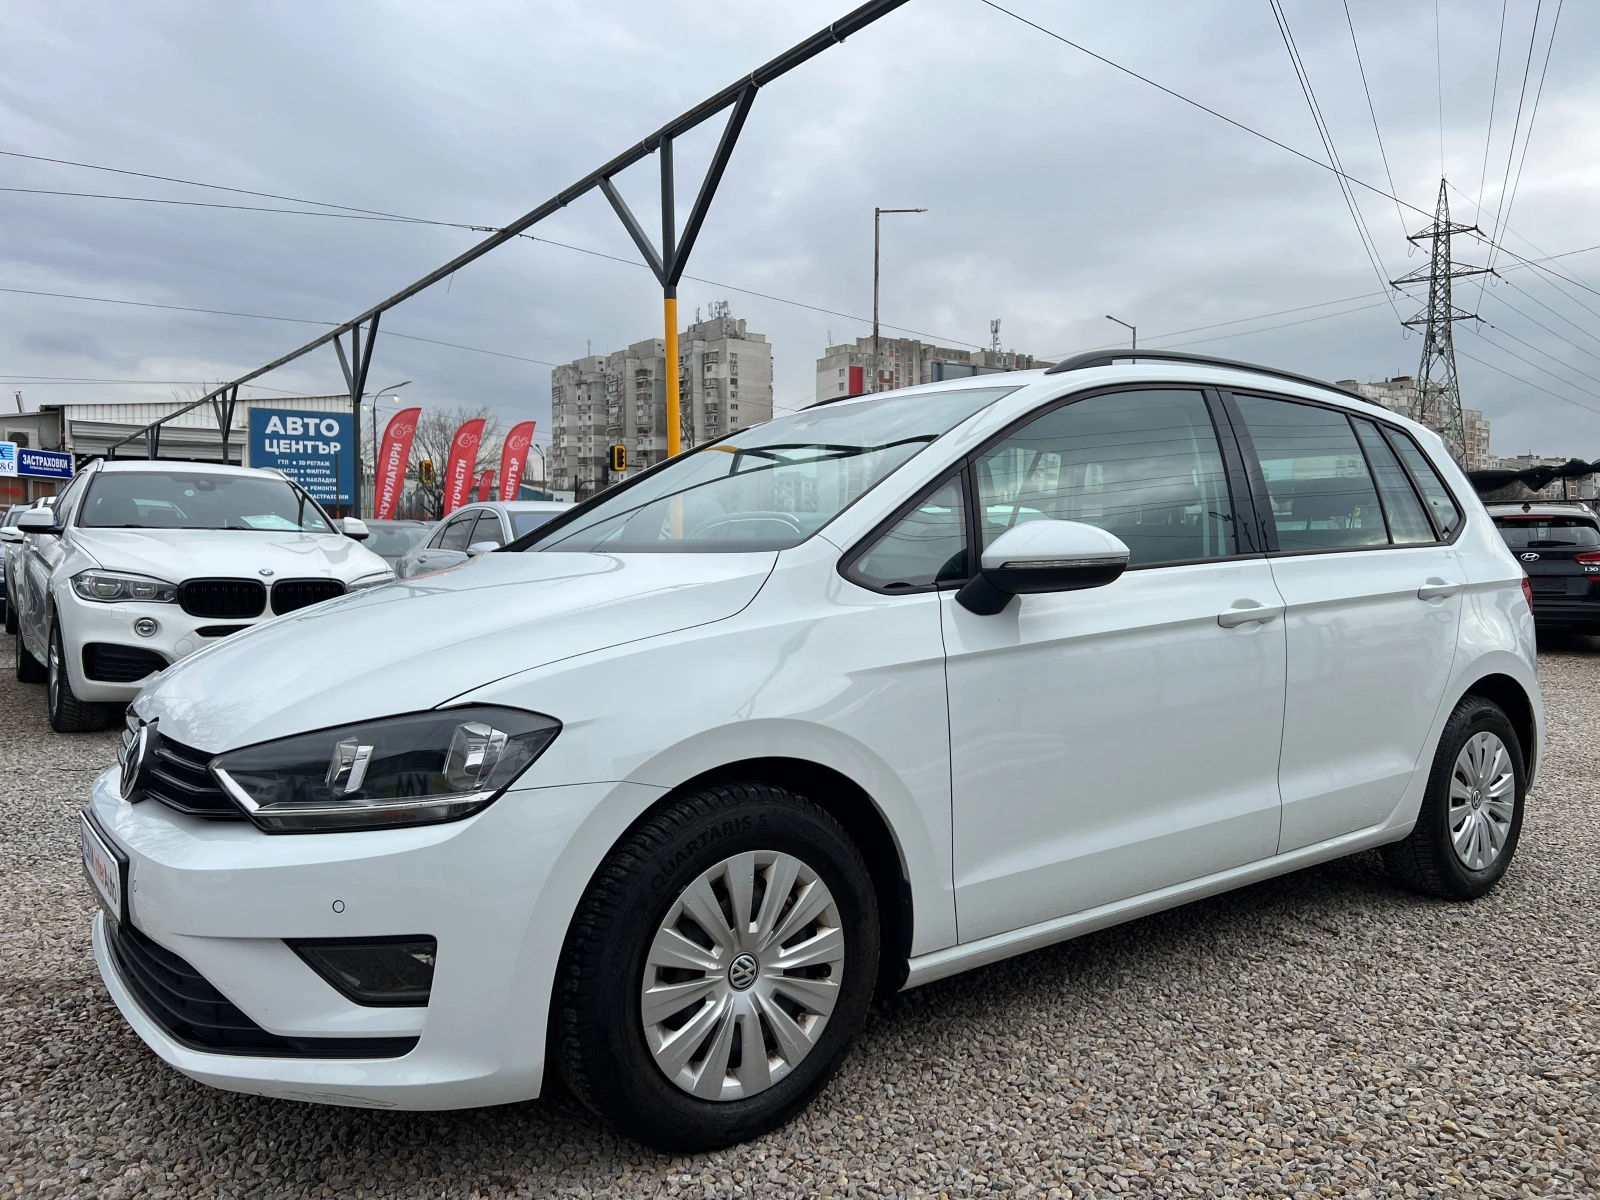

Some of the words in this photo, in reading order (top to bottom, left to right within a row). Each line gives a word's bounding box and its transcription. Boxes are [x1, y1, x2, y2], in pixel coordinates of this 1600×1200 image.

[265, 416, 340, 437] АВТО
[265, 439, 341, 455] ЦЕНТЪР
[23, 454, 68, 469] ЗАСТРАХОВКИ
[651, 816, 752, 891] QUARTARIS
